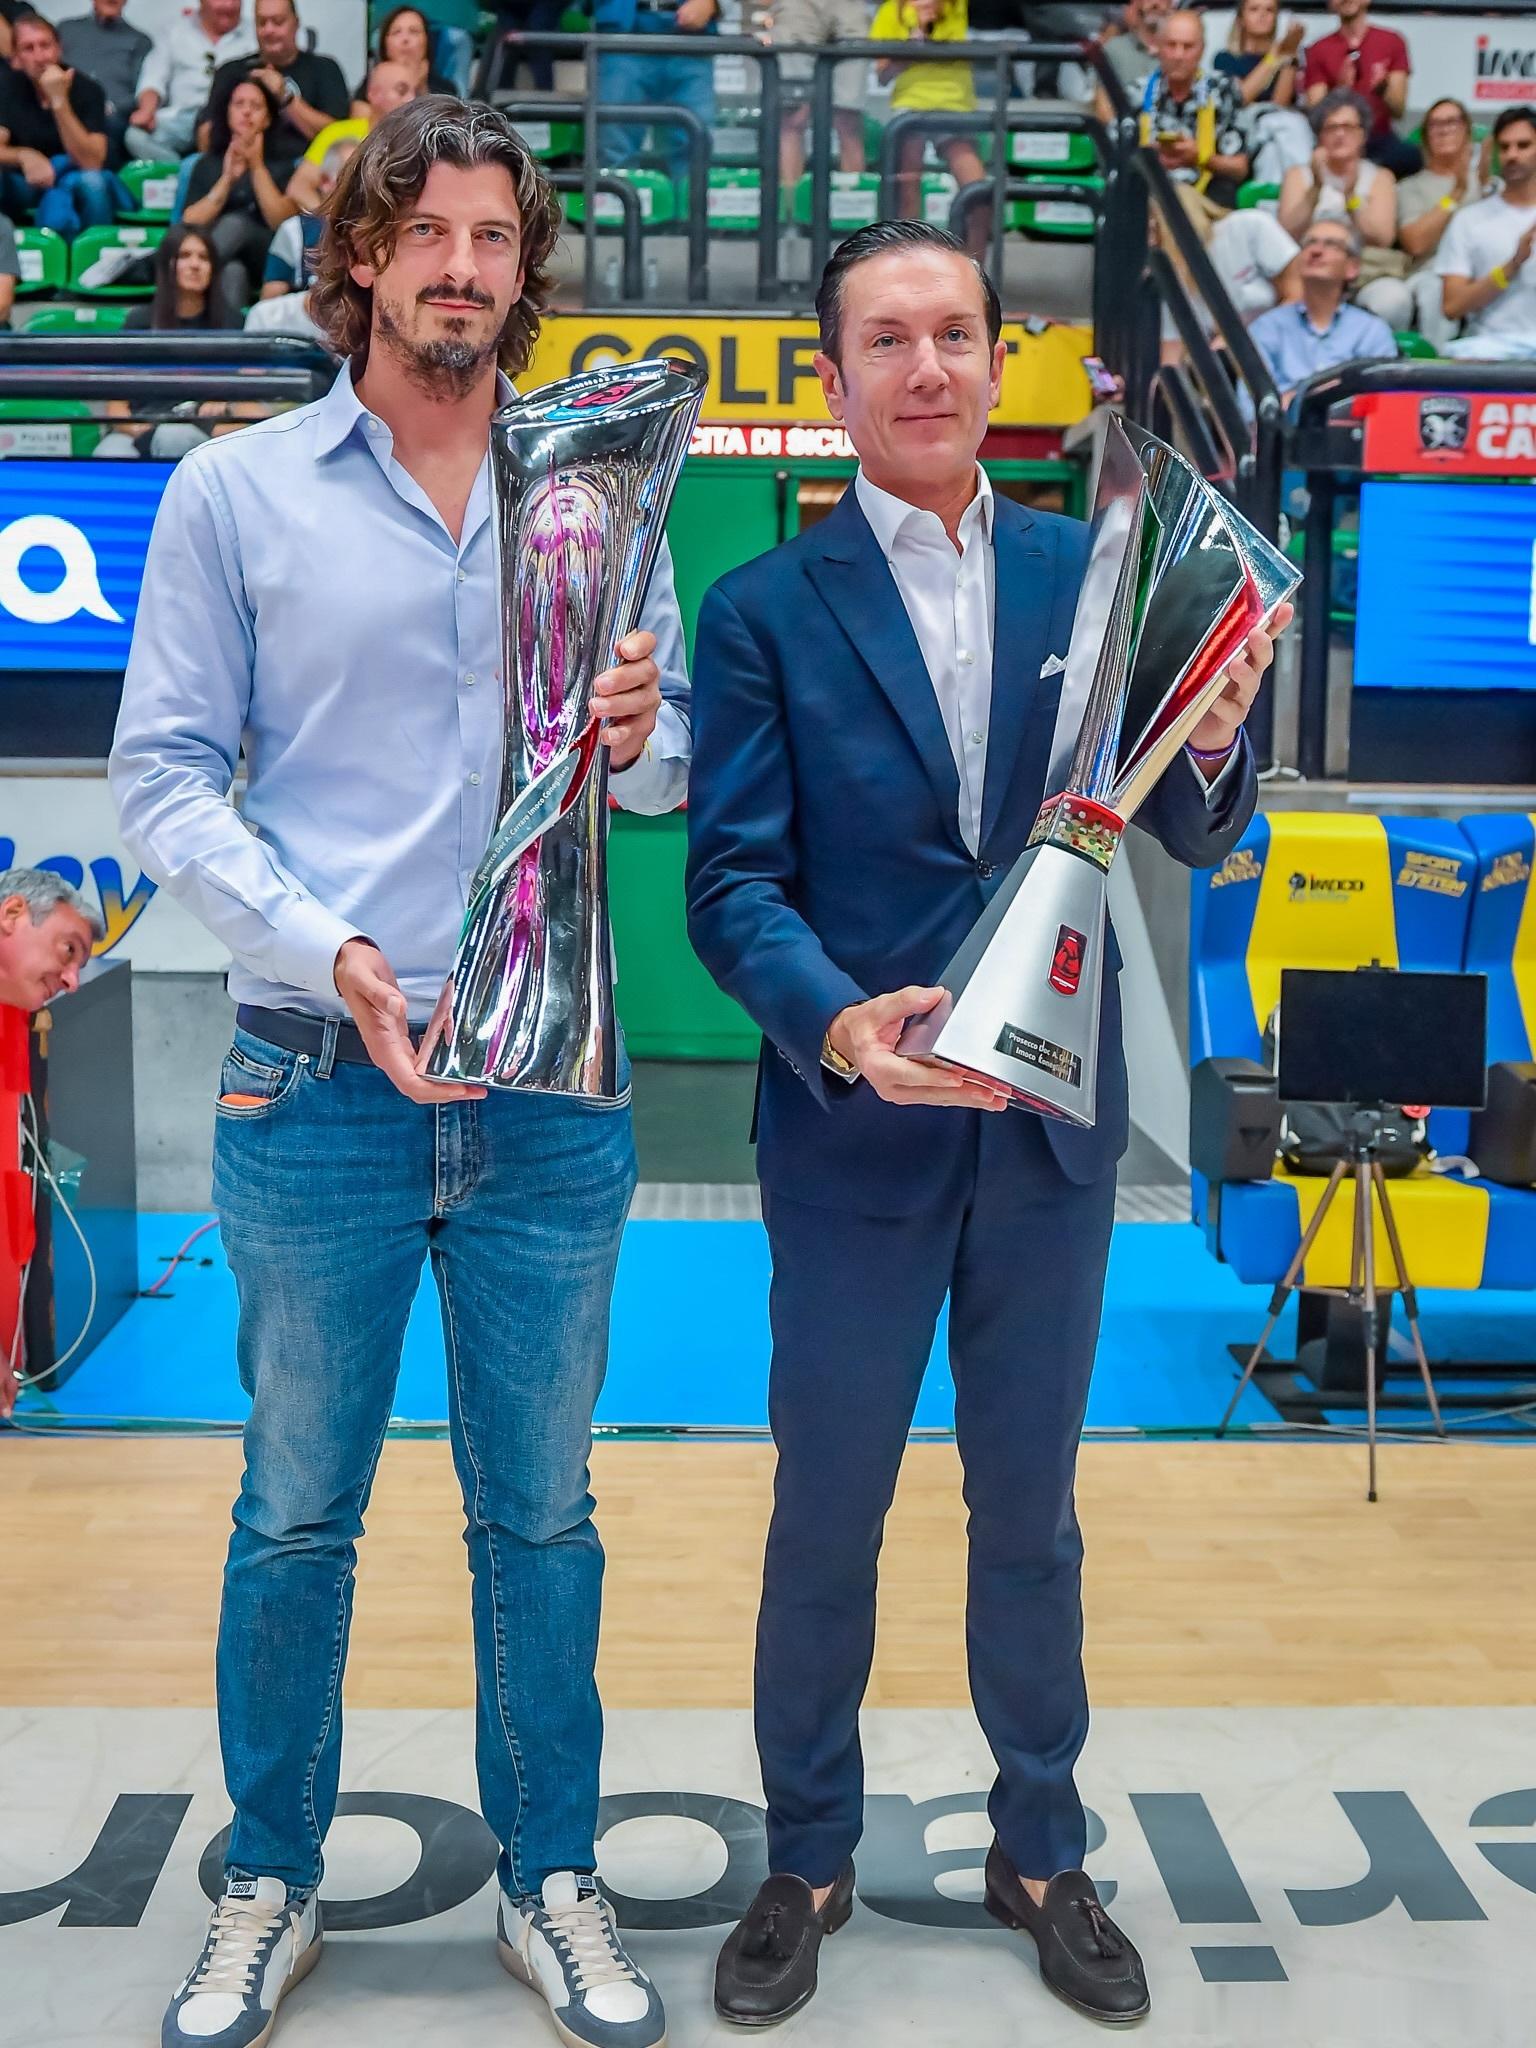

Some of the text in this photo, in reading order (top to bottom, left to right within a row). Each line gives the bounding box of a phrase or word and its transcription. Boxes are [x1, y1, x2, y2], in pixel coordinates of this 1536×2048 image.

[751, 427, 782, 456] DI
[785, 427, 859, 456] SICU
[510, 815, 531, 836] Carraro
[527, 798, 546, 819] Imoco
[542, 765, 571, 800] Conegliano
[1008, 1032, 1039, 1050] Prosecco
[1015, 1046, 1036, 1061] Imoco
